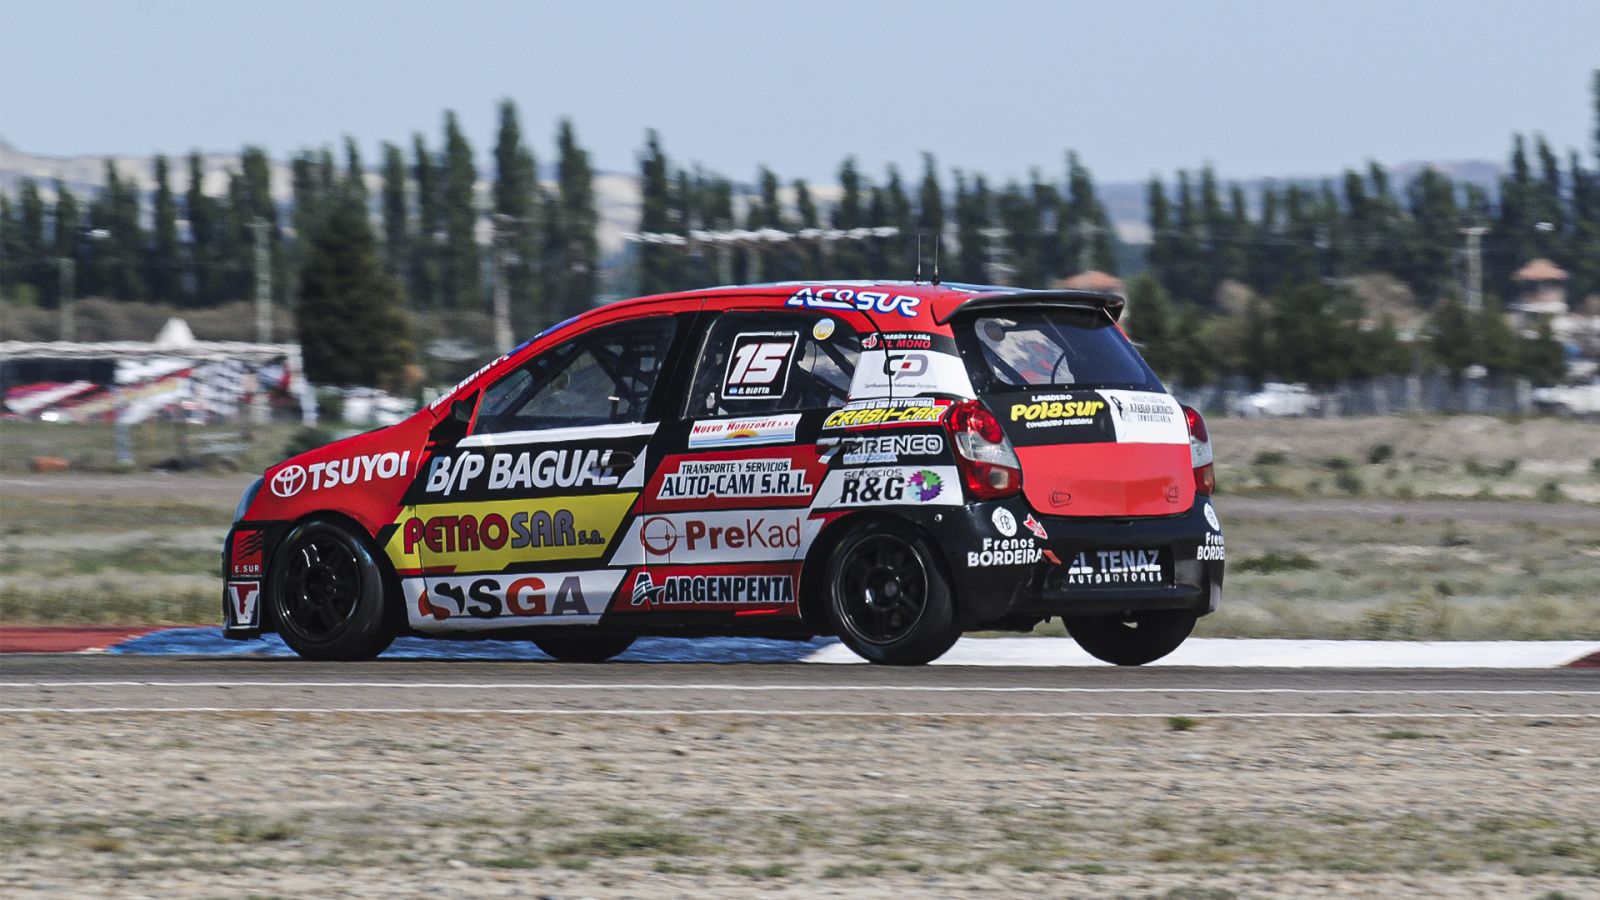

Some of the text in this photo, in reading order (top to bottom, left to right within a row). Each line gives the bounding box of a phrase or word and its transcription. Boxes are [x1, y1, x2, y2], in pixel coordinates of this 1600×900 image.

[896, 339, 932, 349] MONO
[727, 342, 793, 385] 15
[902, 399, 934, 408] PINTURA
[1031, 394, 1074, 402] LAVADERO
[693, 424, 723, 434] NUEVO
[727, 421, 776, 431] HORIZONTE
[308, 450, 410, 491] TSUYOI
[425, 449, 620, 496] B/P BAGUAL
[681, 460, 789, 474] TRANSPORTE Y SERVICIOS
[844, 468, 903, 484] SERVICIOS
[660, 470, 812, 497] AUTO-CAM S.R.L.
[840, 475, 905, 504] R&G
[404, 509, 574, 555] PETROSAR
[685, 517, 801, 551] PreKad
[983, 537, 1035, 551] Frenos
[967, 548, 1042, 567] BORDEIRA
[1068, 549, 1161, 575] EL TENAZ
[1068, 571, 1162, 585] AUTOMOTORES
[662, 575, 795, 604] ARGENPENTA
